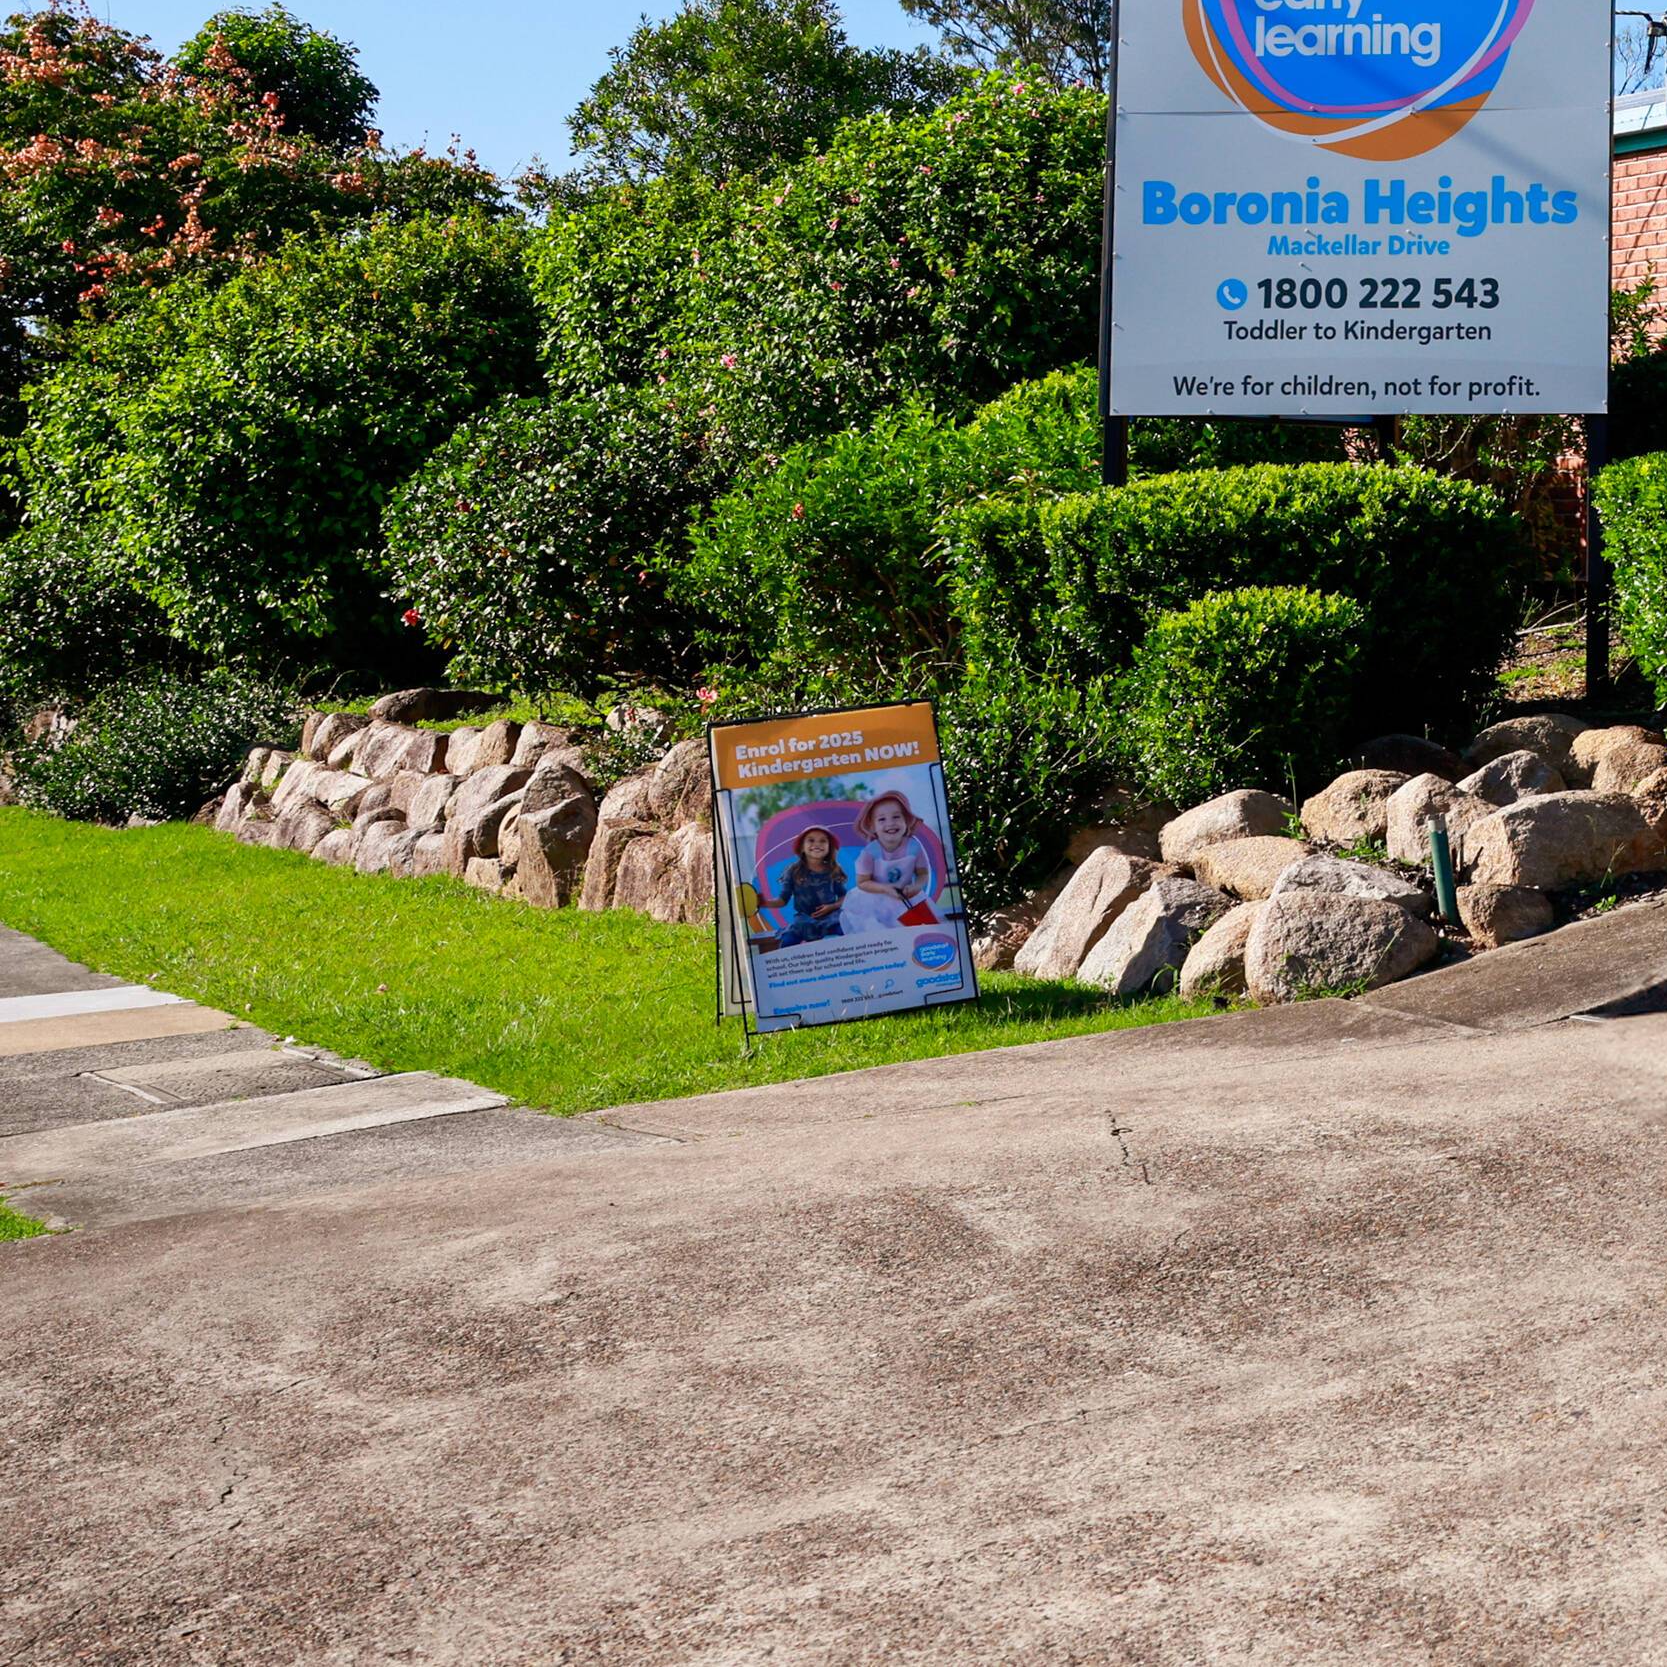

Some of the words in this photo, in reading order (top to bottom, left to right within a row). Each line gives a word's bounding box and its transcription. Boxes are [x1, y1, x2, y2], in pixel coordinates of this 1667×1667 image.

[1255, 15, 1441, 67] learning
[1142, 176, 1350, 226] Boronia
[1364, 175, 1579, 238] Heights
[1267, 234, 1382, 256] Mackellar
[1388, 235, 1450, 256] Drive
[1257, 278, 1348, 310] 1800
[1359, 278, 1421, 309] 222
[1432, 277, 1501, 309] 543
[1223, 320, 1307, 342] Toddler
[1313, 324, 1338, 342] to
[1344, 321, 1493, 347] Kindergarten
[1173, 376, 1236, 397] We're
[1241, 375, 1274, 396] for
[1280, 375, 1377, 400] children,
[1384, 378, 1422, 397] not
[1427, 376, 1463, 397] for
[1469, 376, 1541, 401] profit.
[735, 739, 785, 760] Enrol
[788, 737, 816, 753] for
[819, 730, 864, 749] 2025
[737, 752, 862, 779] Kindergarten
[864, 741, 920, 762] NOW!
[915, 971, 961, 988] goodstar
